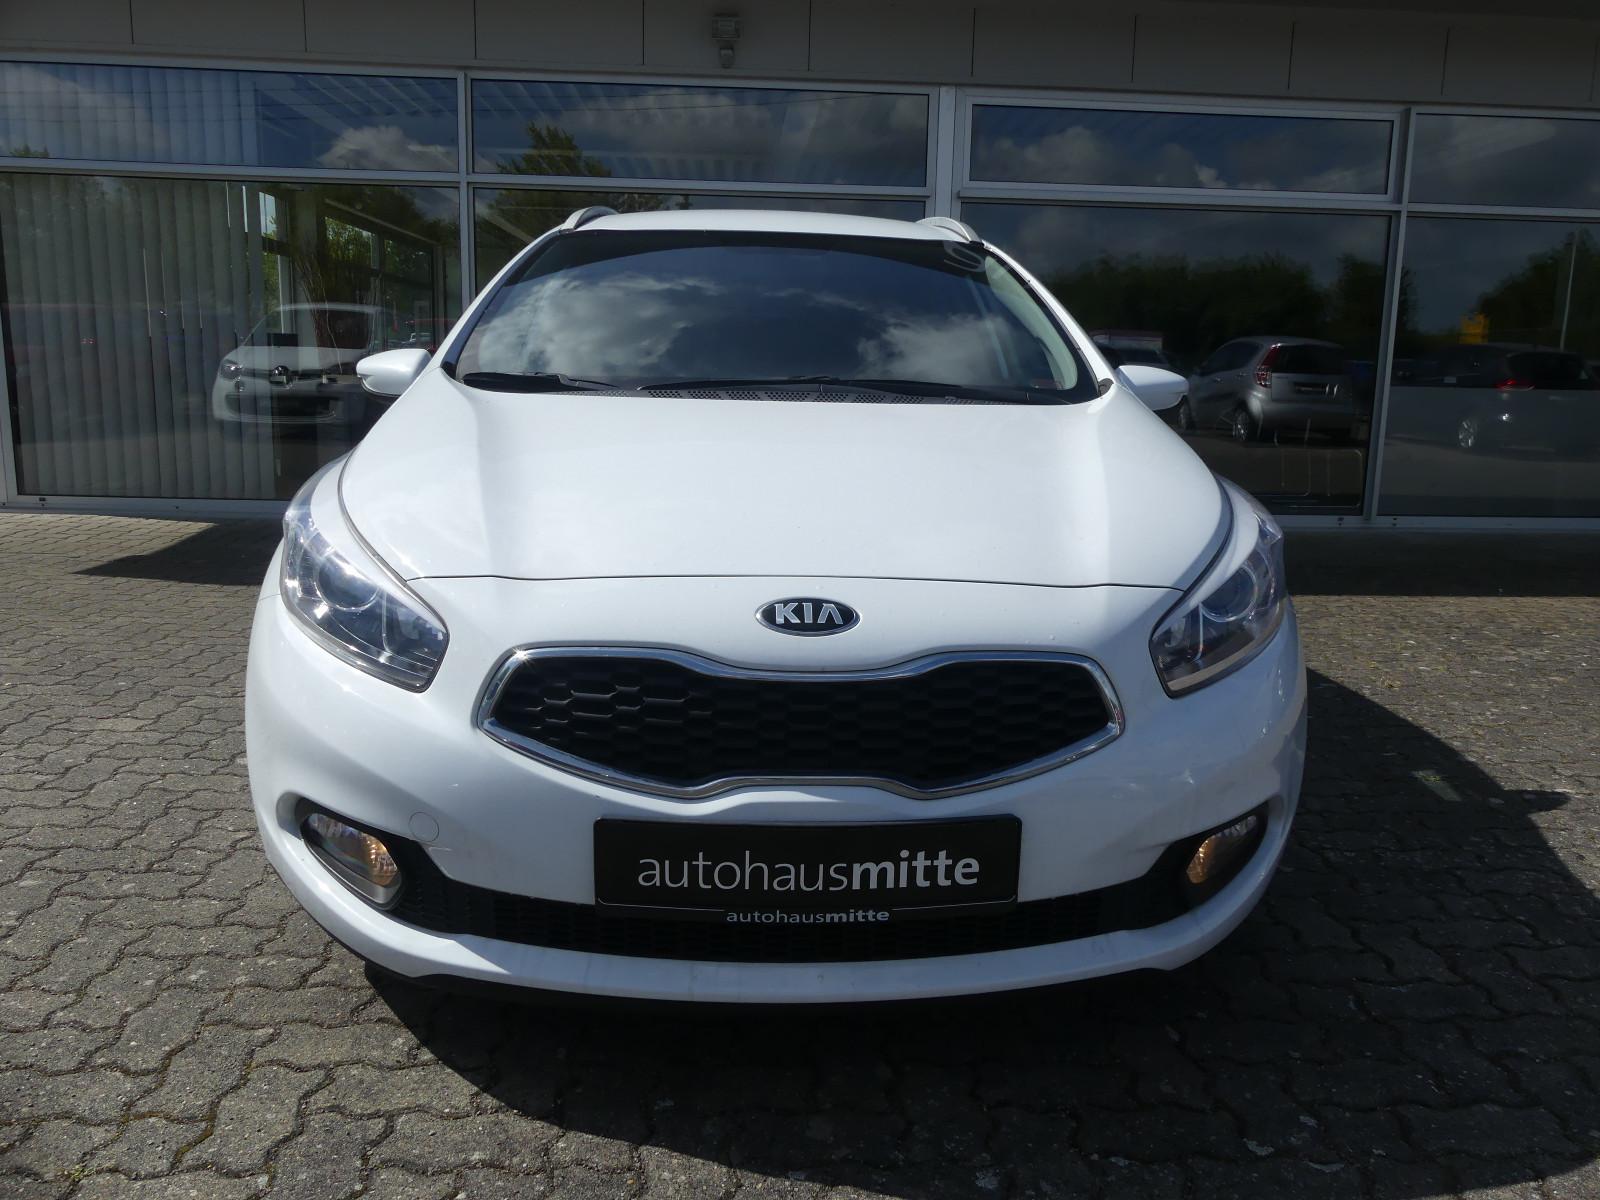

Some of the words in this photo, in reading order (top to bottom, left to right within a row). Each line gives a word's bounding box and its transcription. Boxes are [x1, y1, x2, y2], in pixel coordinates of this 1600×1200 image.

[774, 602, 844, 625] KIA
[637, 849, 980, 891] autohausmitte
[726, 908, 890, 924] autohausmitte
